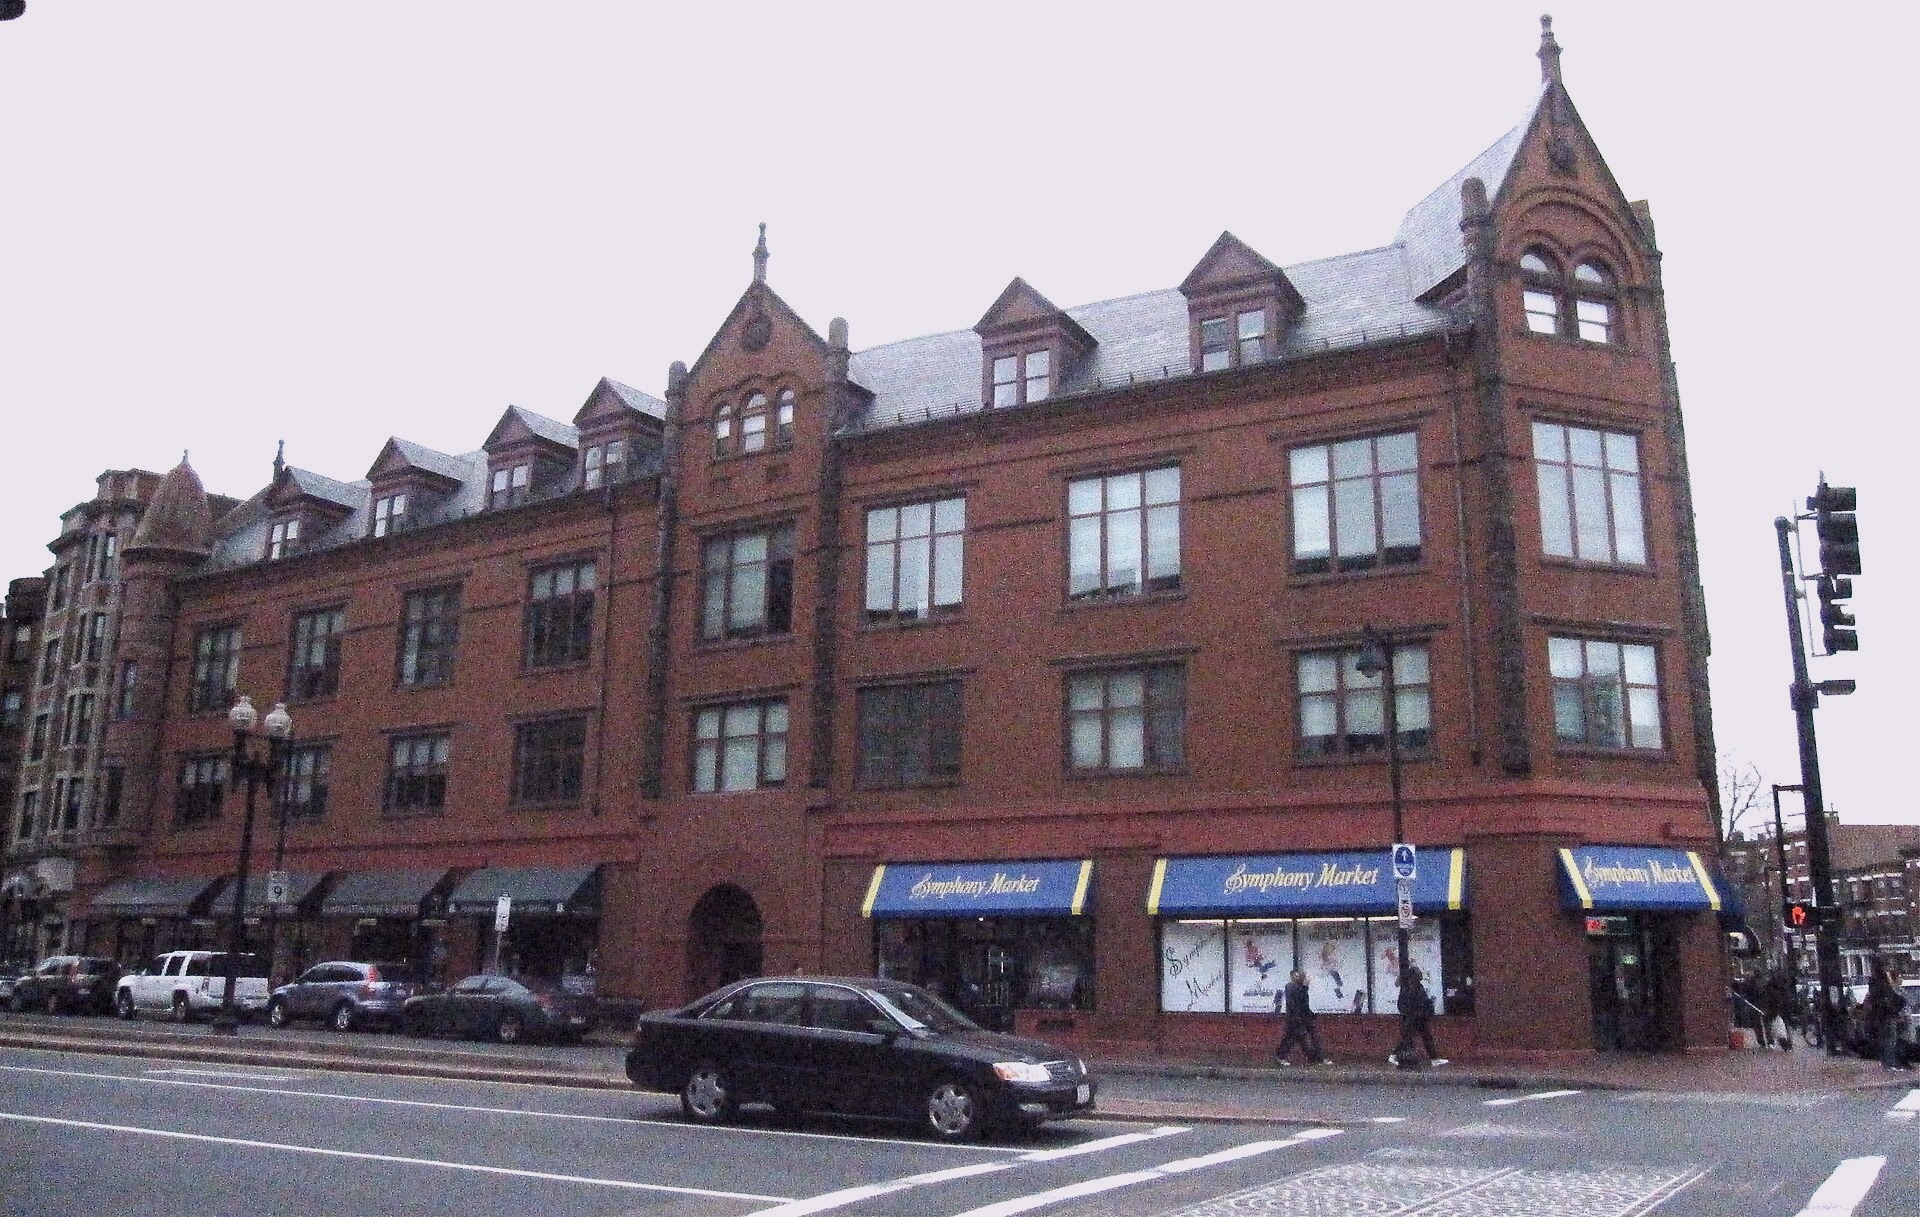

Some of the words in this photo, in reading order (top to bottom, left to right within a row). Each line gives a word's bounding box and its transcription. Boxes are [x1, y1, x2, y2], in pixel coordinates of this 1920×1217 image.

[908, 872, 985, 898] Symphony
[985, 872, 1041, 894] Market
[1224, 864, 1314, 894] Symphony
[1316, 861, 1378, 886] Market
[1585, 857, 1648, 886] Symphony
[1650, 860, 1696, 884] Market
[273, 884, 284, 900] 9
